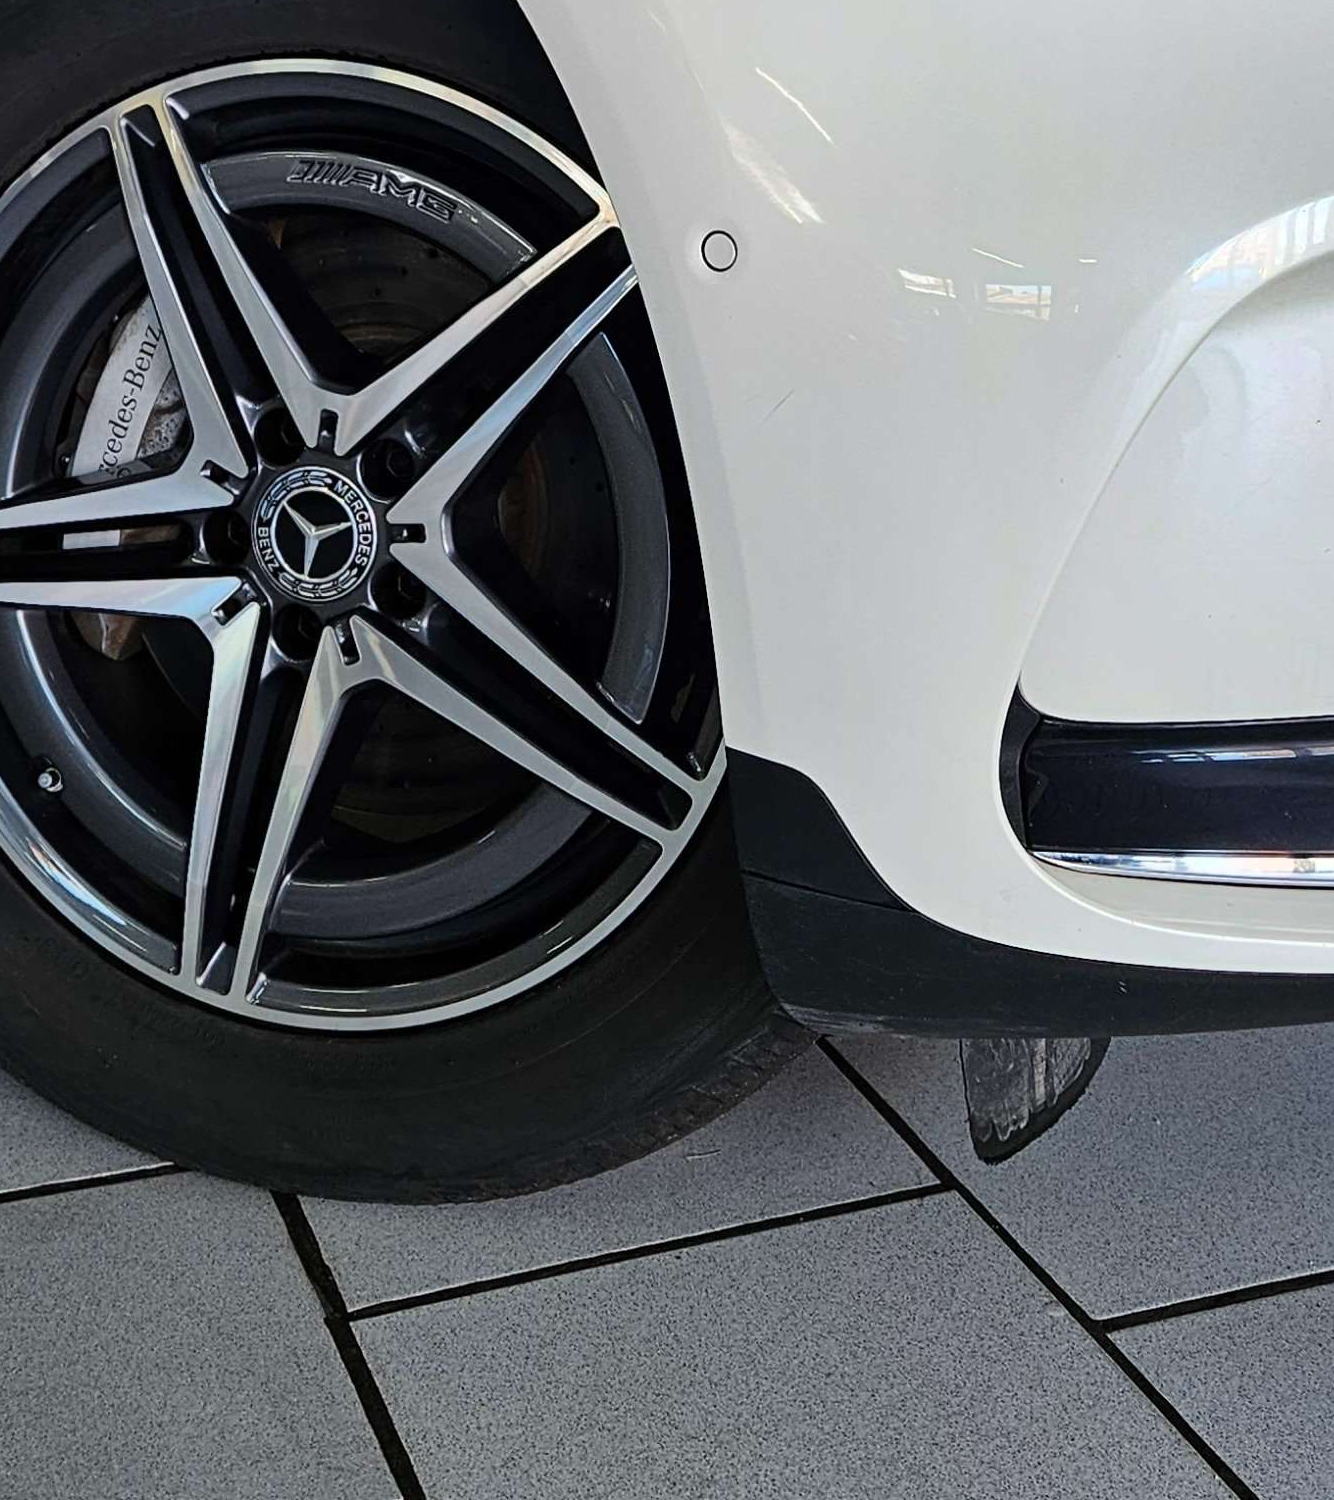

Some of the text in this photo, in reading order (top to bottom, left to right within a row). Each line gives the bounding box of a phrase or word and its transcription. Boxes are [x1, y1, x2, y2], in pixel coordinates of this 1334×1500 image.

[338, 164, 457, 224] AMG
[99, 324, 163, 477] rcedes-Benz
[257, 527, 281, 573] BENZ
[332, 478, 373, 568] MERCEDES
